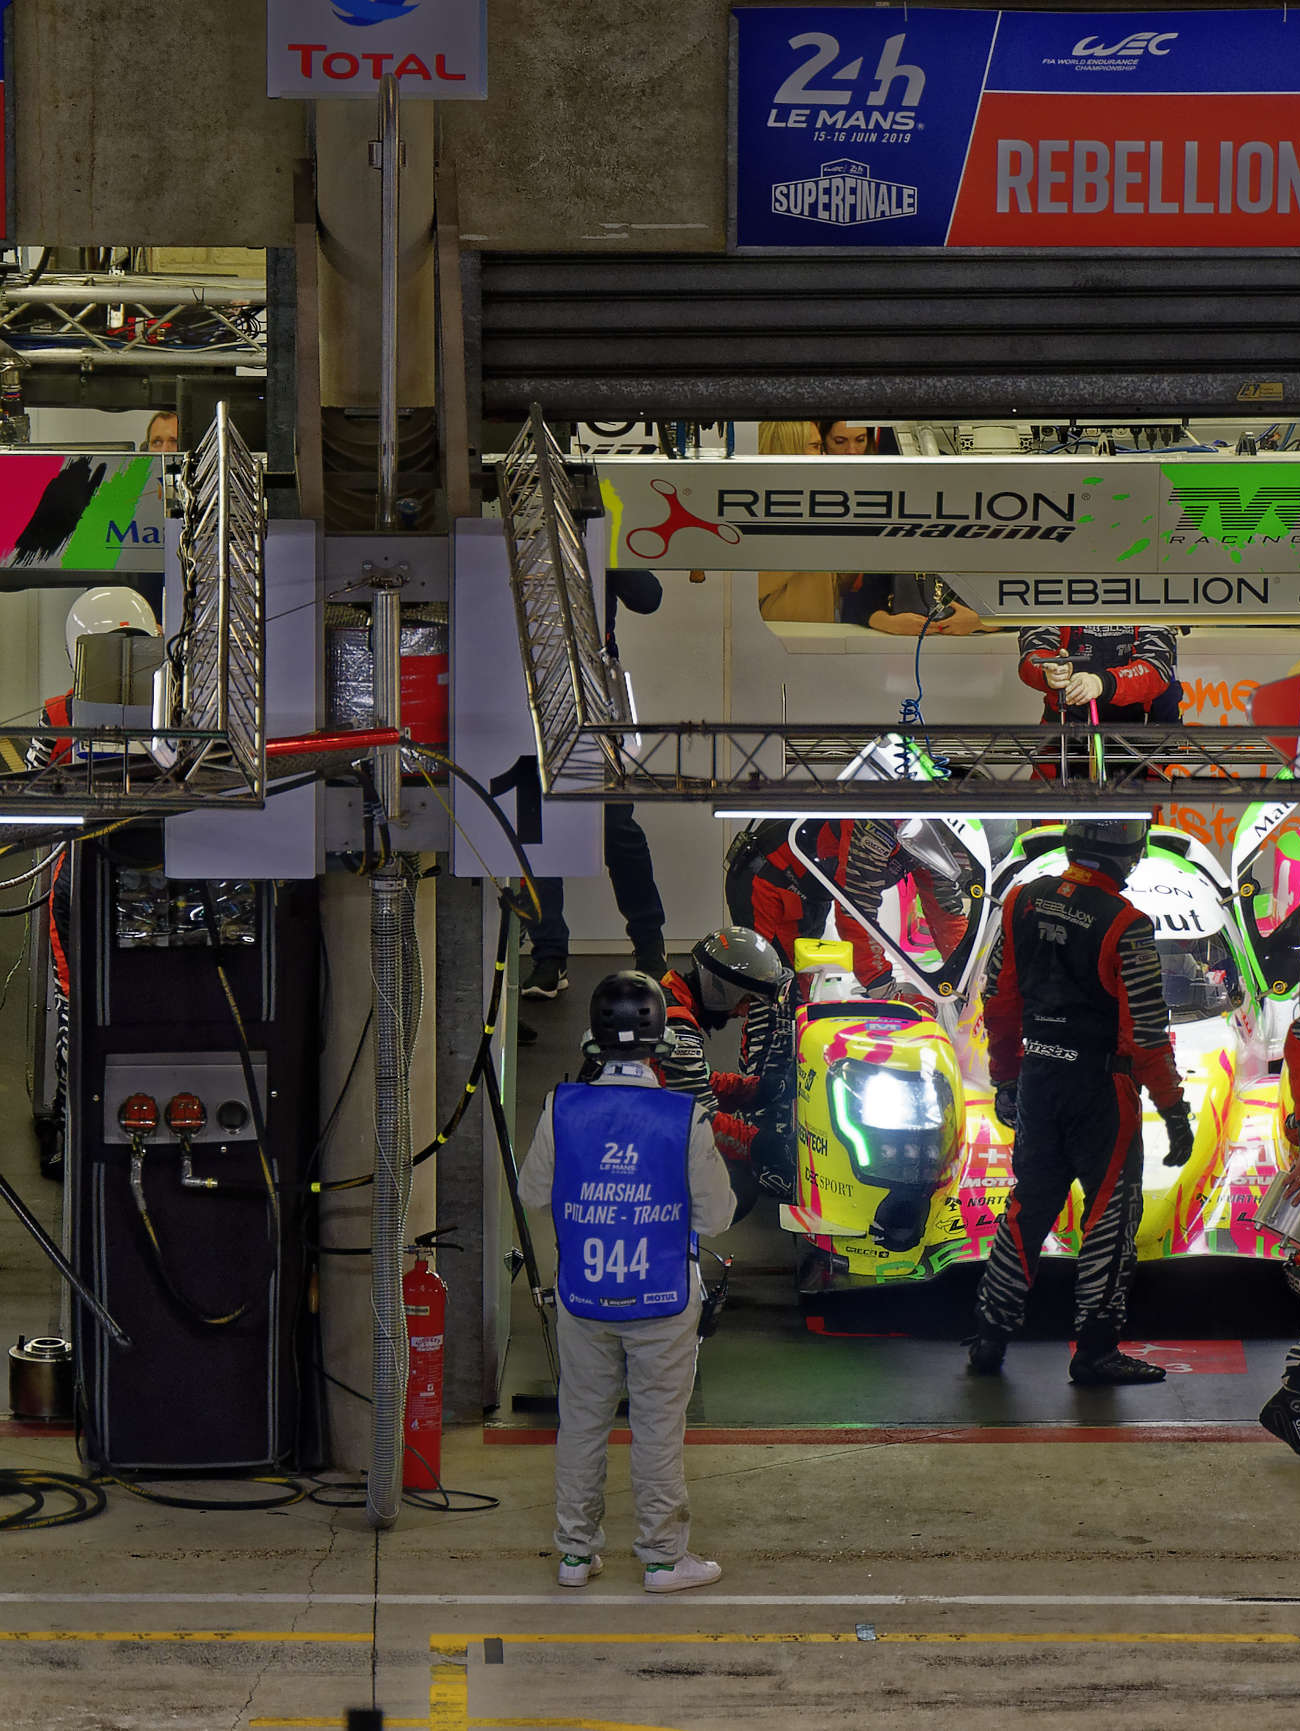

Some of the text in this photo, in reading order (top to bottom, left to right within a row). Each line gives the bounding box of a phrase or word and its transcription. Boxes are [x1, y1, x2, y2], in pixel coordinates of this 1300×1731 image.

[1072, 32, 1179, 56] WEC
[287, 43, 467, 82] TOTAL
[773, 31, 927, 106] 24h
[767, 109, 811, 128] LE
[813, 131, 911, 143] 15-16 JUIN 2019
[774, 177, 916, 223] SUPERFINALE
[717, 488, 1075, 521] REBELLION
[998, 577, 1270, 606] REBELLION
[580, 1182, 652, 1202] MARSHAL
[819, 1175, 854, 1198] SPORT
[633, 1203, 684, 1225] TRACK
[582, 1236, 650, 1284] 944
